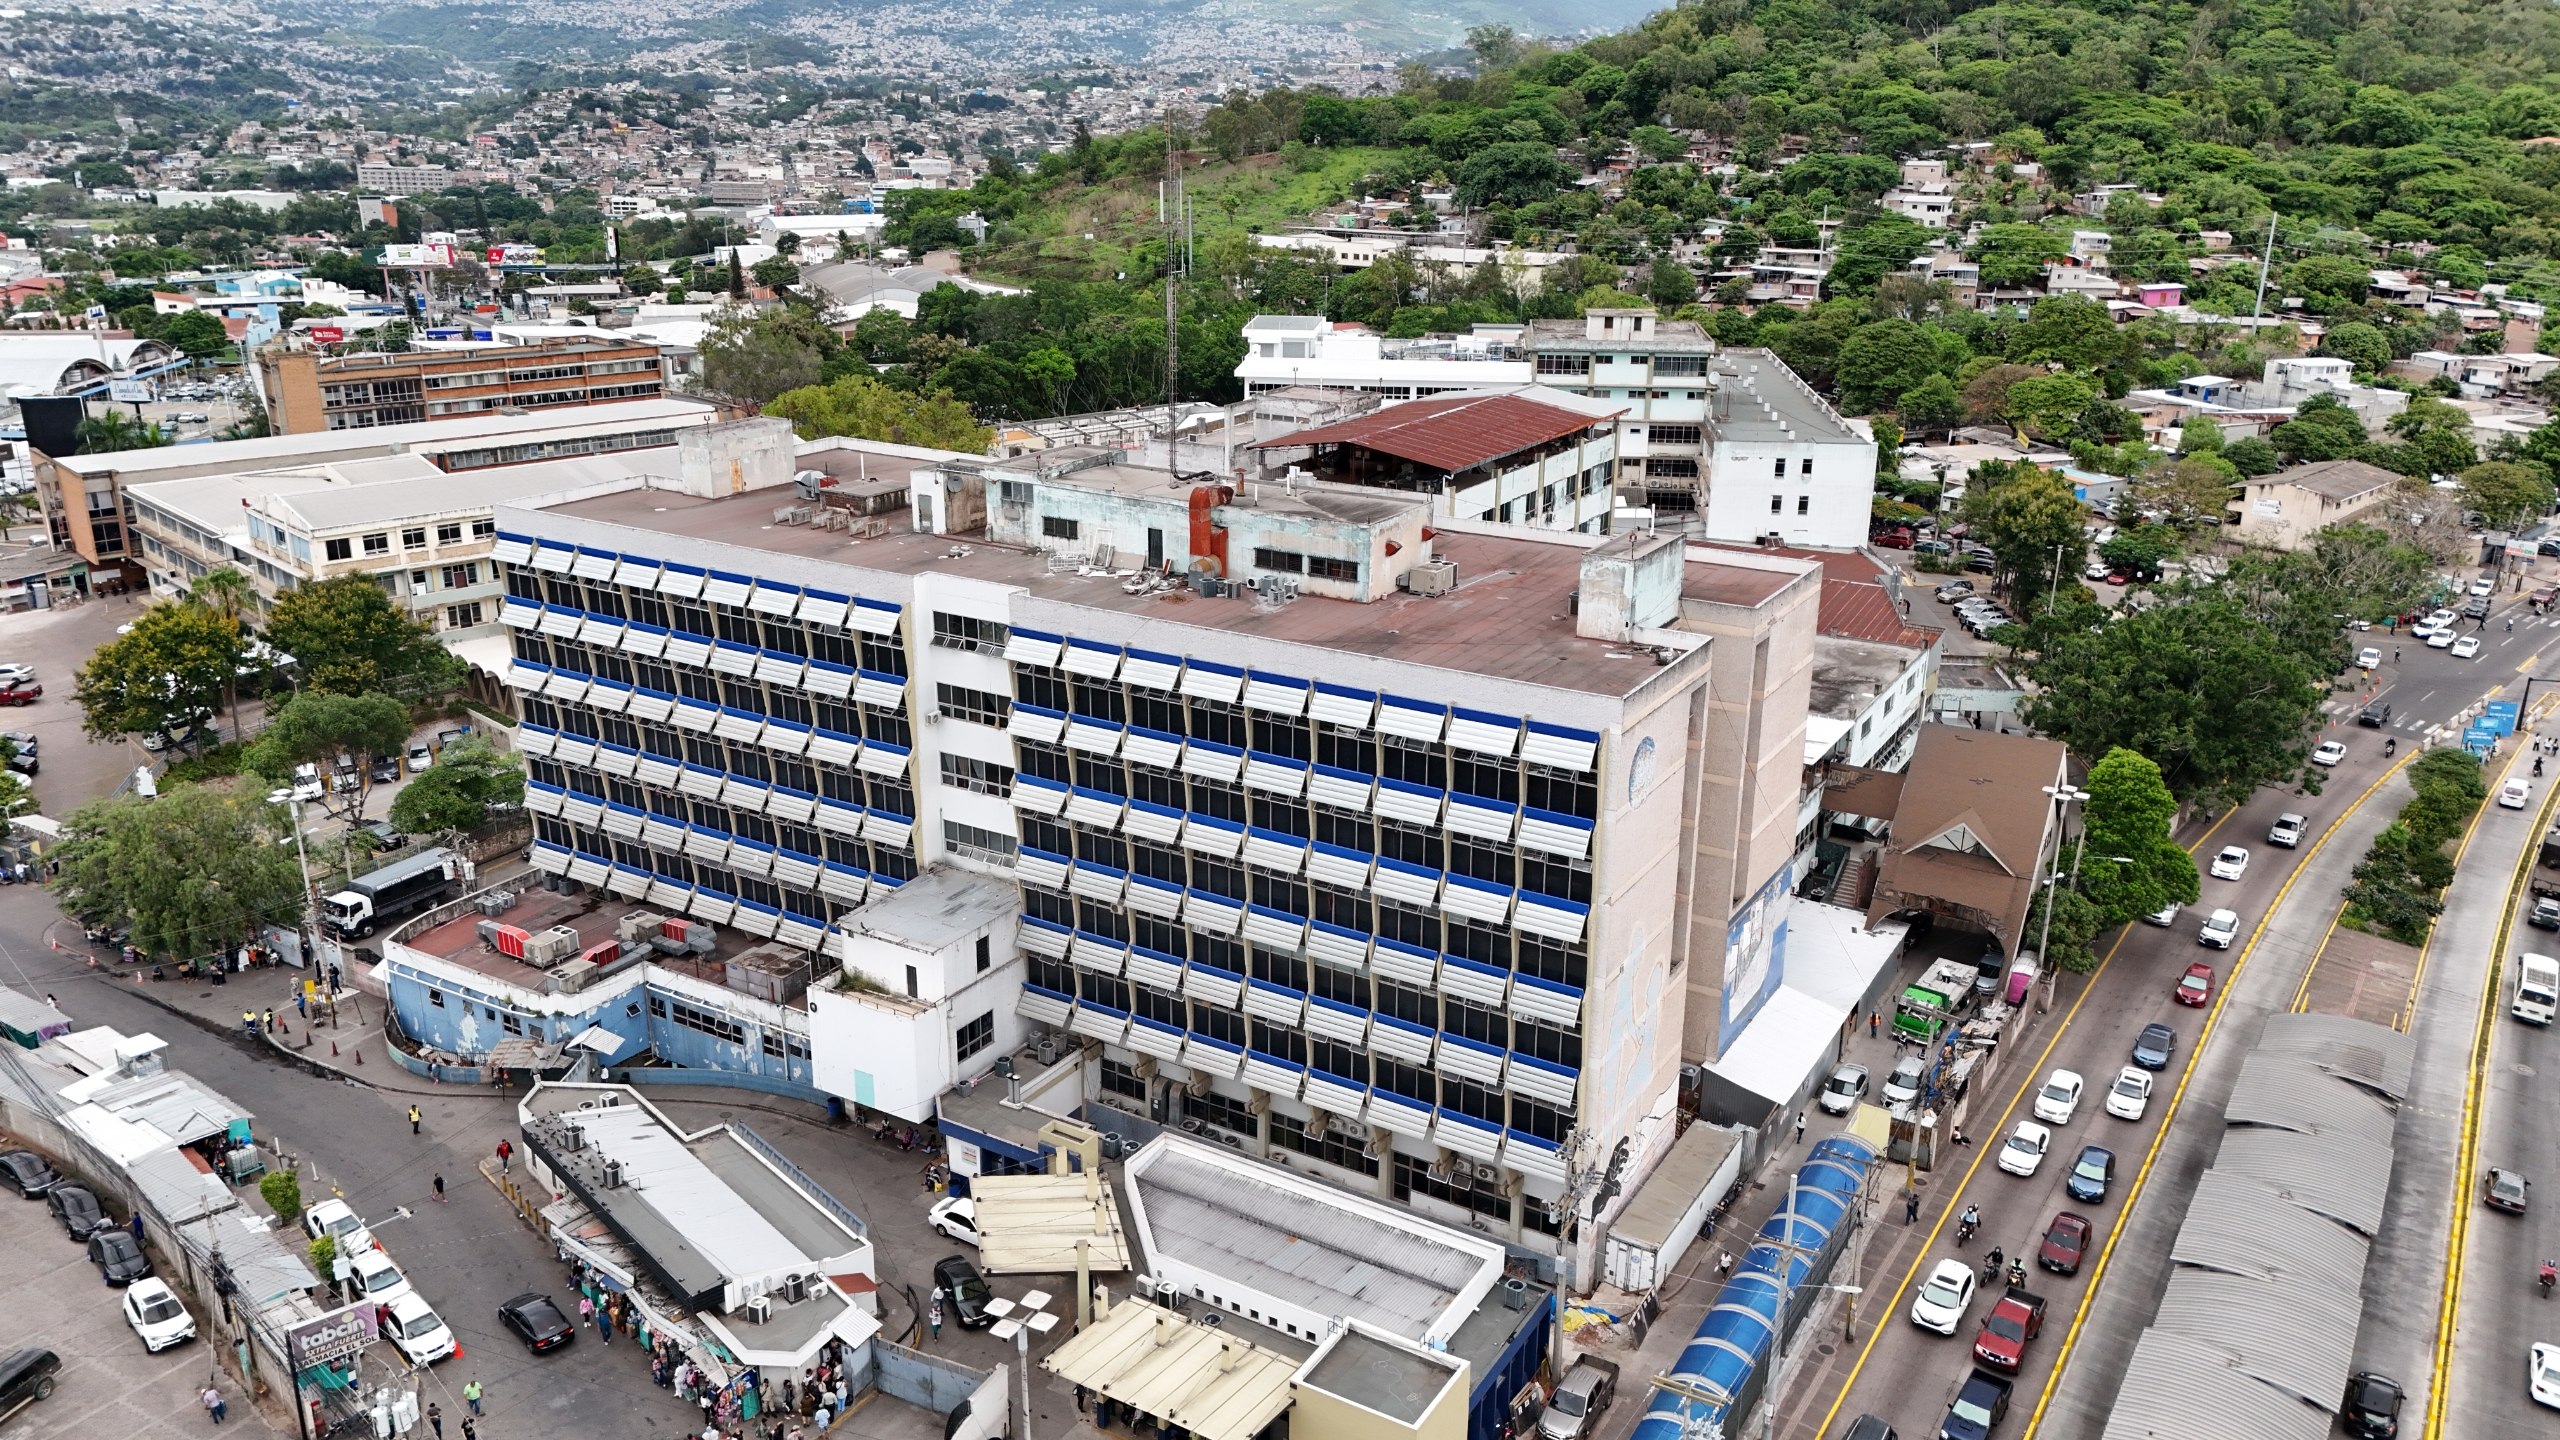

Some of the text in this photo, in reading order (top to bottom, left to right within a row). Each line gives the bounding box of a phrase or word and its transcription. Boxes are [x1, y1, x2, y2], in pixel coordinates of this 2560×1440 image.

[300, 1311, 366, 1351] tabcin
[305, 1329, 367, 1358] EXTRA FUERTE
[300, 1335, 377, 1368] ARMACIA EL SOL
